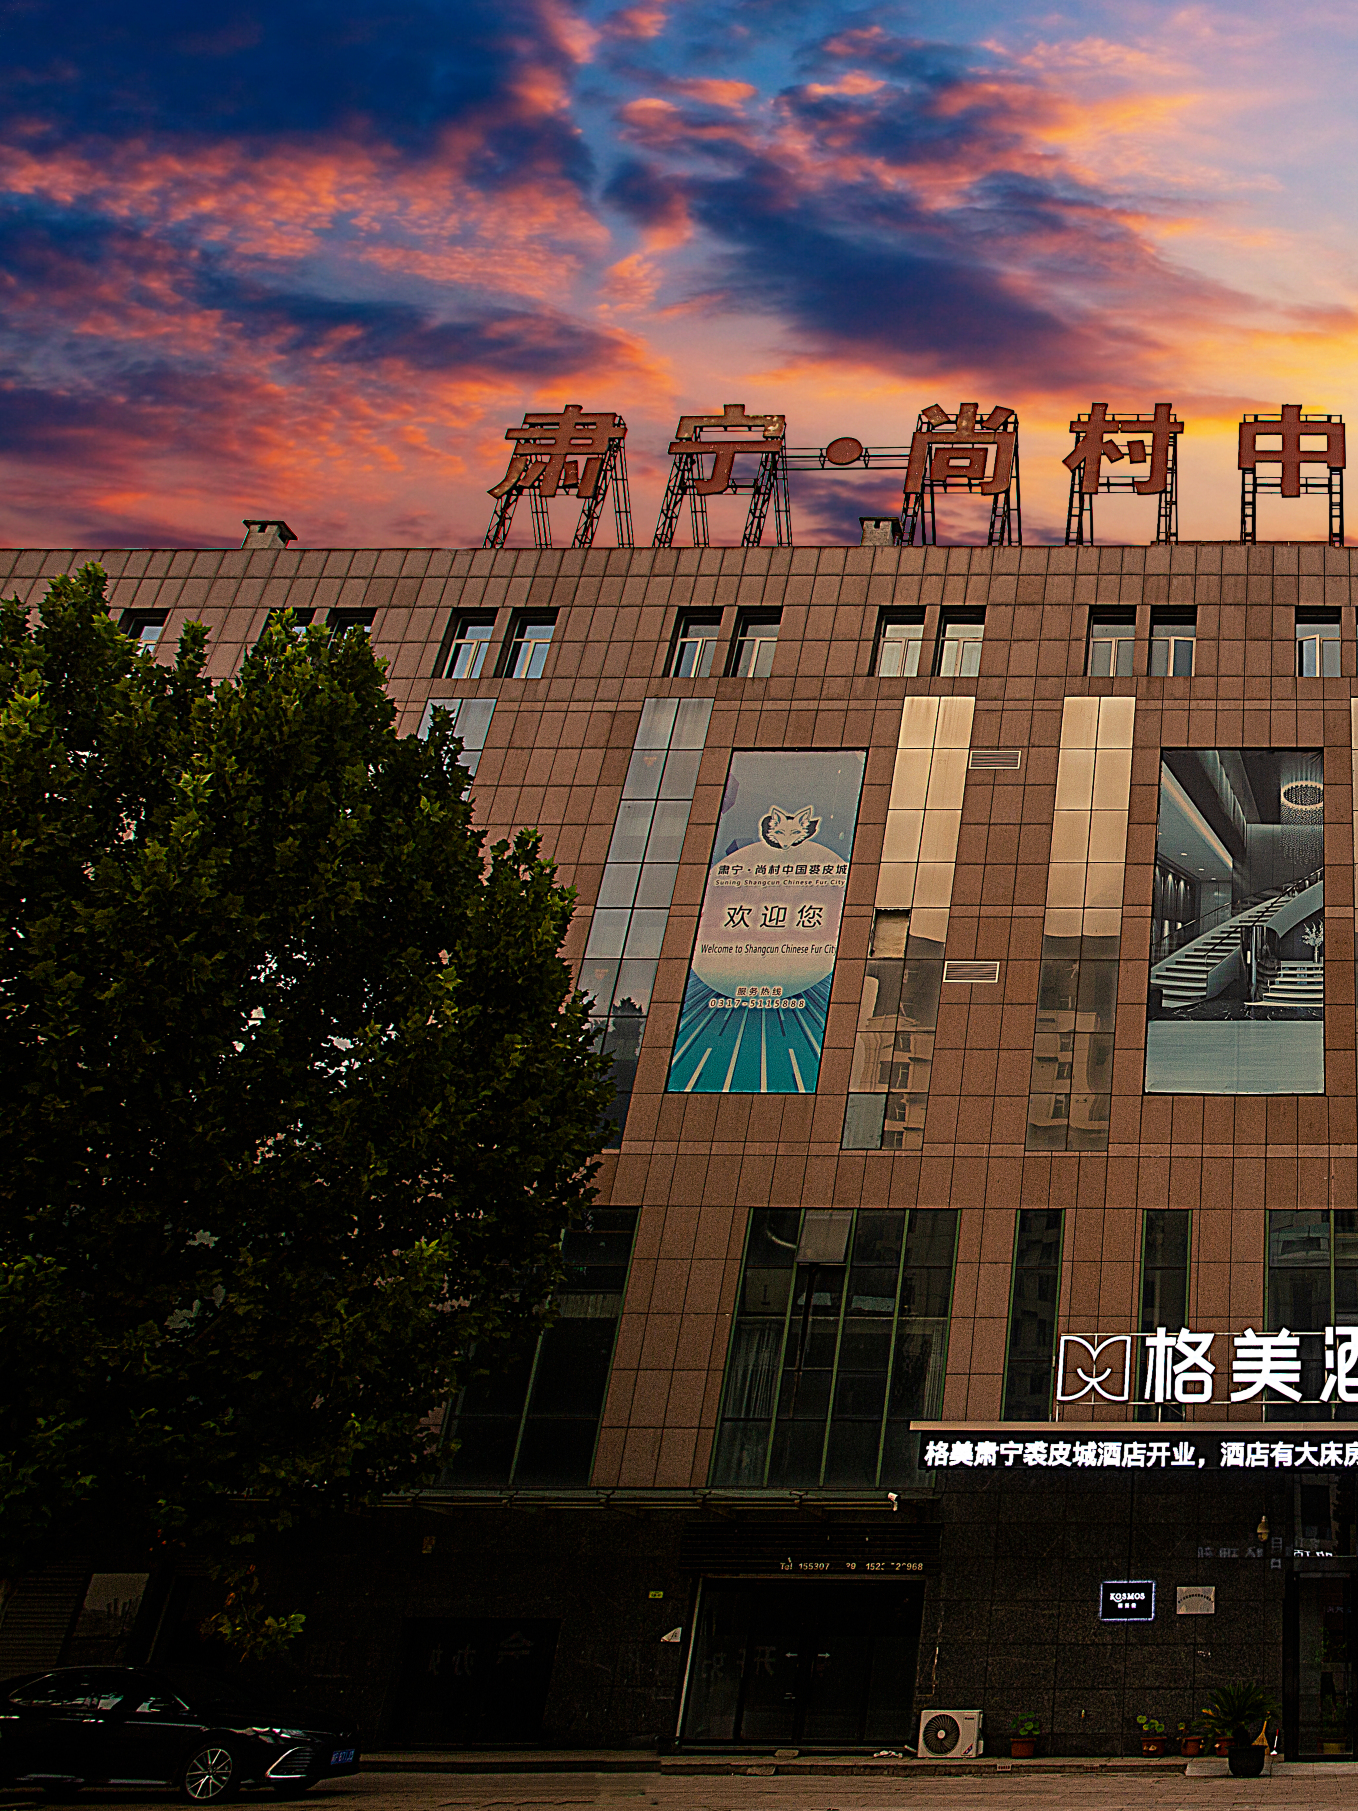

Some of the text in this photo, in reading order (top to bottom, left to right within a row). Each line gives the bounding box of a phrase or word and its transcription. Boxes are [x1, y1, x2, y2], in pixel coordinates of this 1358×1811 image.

[715, 879, 741, 887] Suning
[744, 879, 780, 887] Shangcun
[830, 879, 846, 887] City
[724, 904, 824, 929] 欢迎您
[701, 944, 733, 954] Welcome
[735, 945, 743, 954] to
[744, 944, 779, 957] Shangcun
[781, 944, 809, 954] Chinese
[811, 944, 823, 954] Fur
[736, 987, 783, 997] 服务热线
[708, 999, 806, 1008] 0317-5115888
[1109, 1592, 1146, 1603] KOSMOS
